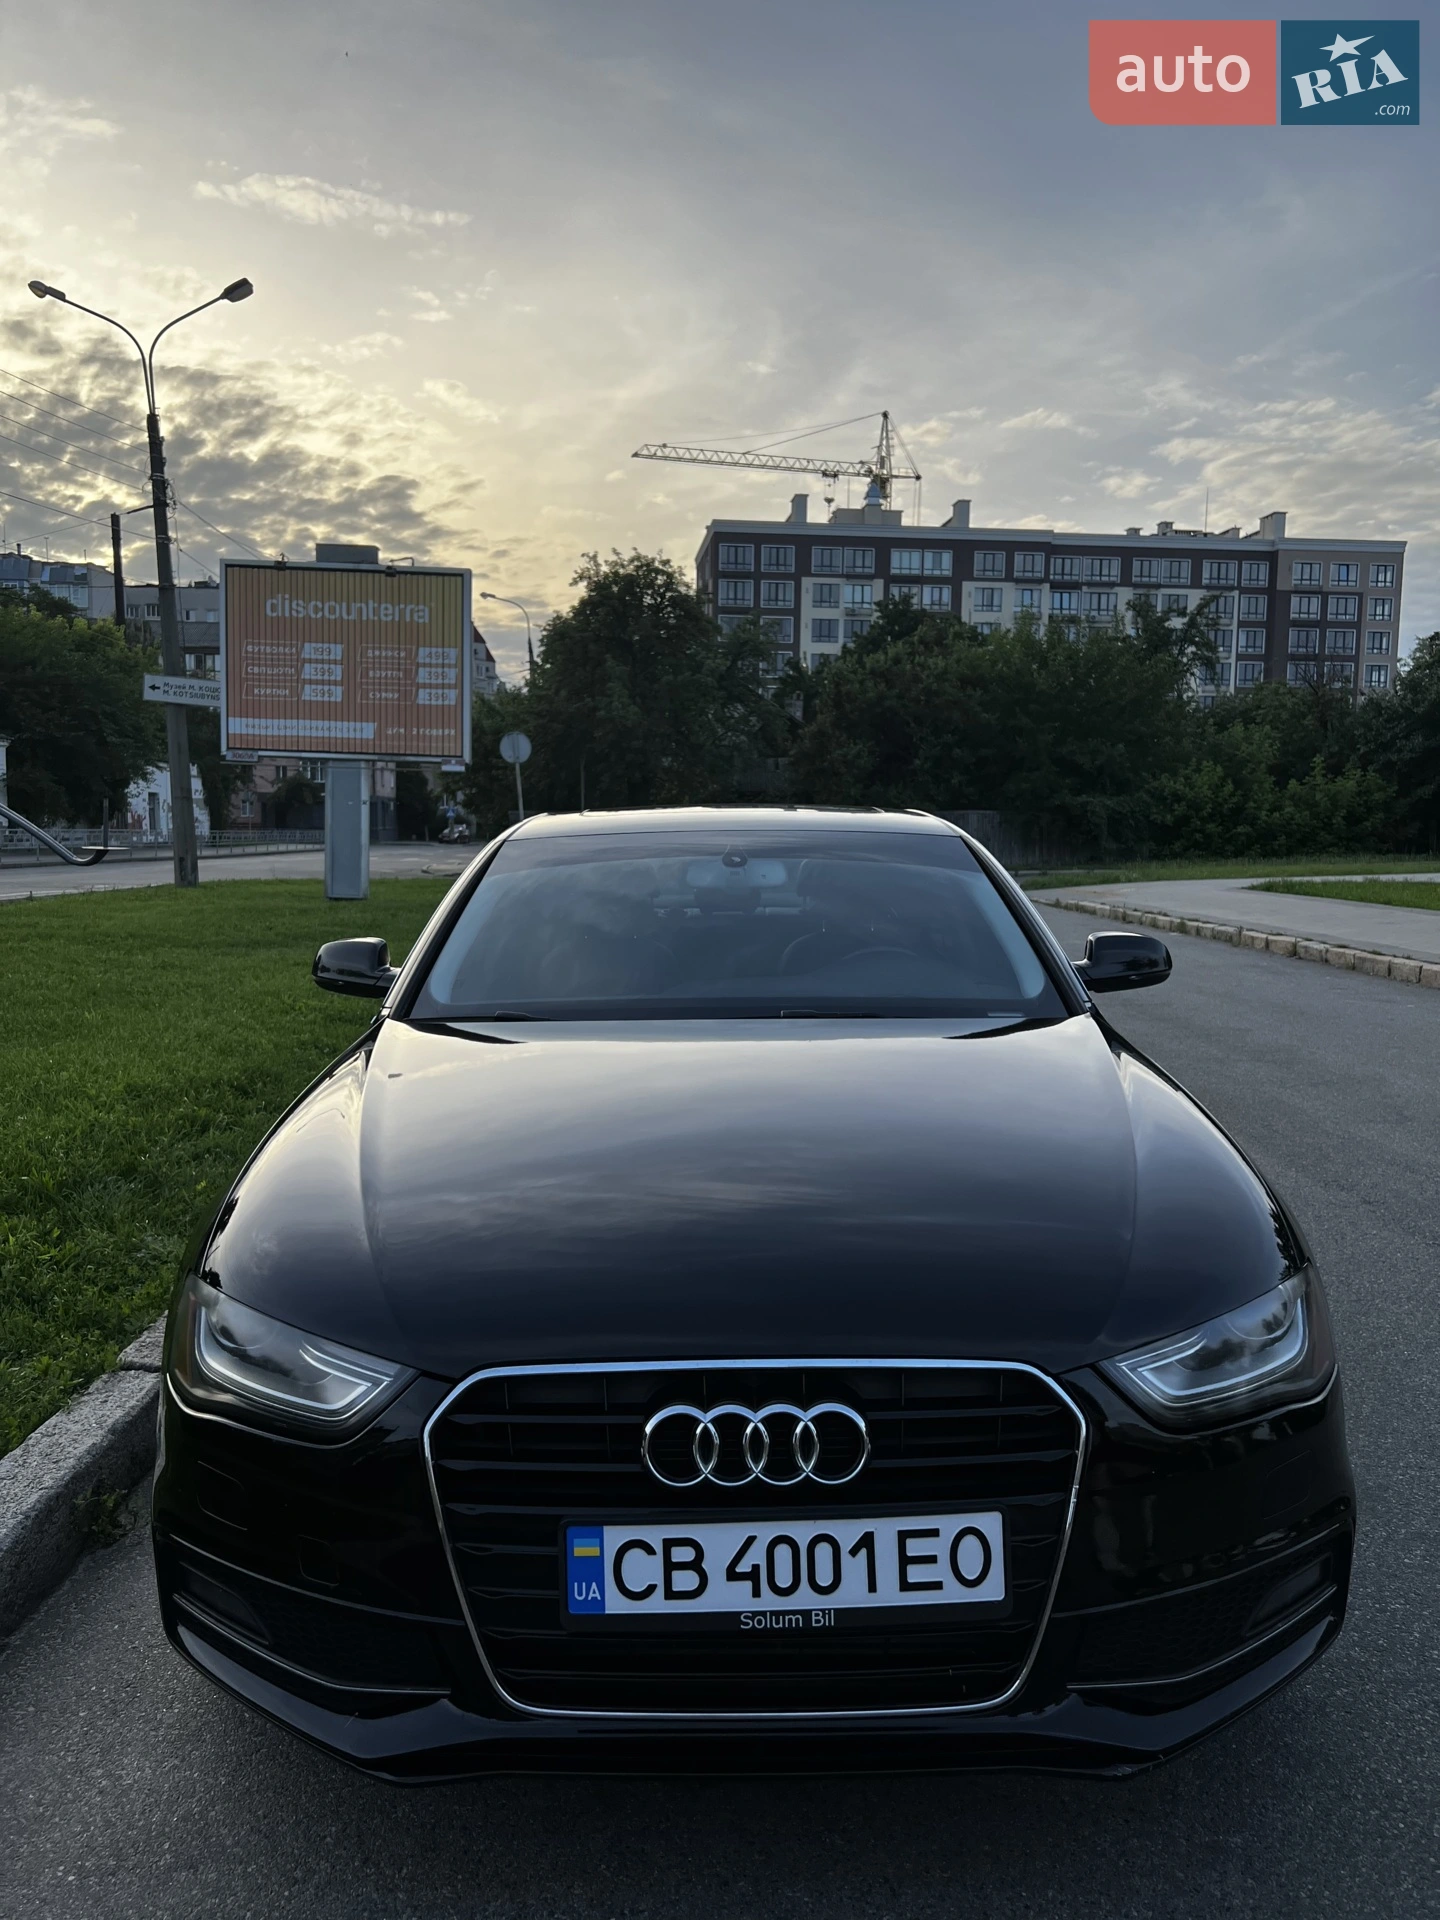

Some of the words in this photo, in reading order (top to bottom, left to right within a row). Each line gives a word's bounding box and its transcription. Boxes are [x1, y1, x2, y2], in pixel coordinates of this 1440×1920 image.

[265, 594, 430, 624] discounterra
[312, 646, 332, 656] 199
[427, 651, 449, 661] 499
[312, 667, 334, 677] 399
[426, 671, 448, 681] 399
[163, 682, 186, 690] Музей
[254, 687, 289, 696] КУРТКИ
[312, 688, 334, 698] 599
[426, 692, 448, 702] 399
[612, 1536, 709, 1601] CB
[725, 1530, 878, 1598] 4001
[897, 1526, 993, 1593] EO
[574, 1582, 601, 1600] UA
[740, 1611, 803, 1629] Solum
[811, 1609, 835, 1627] Bil
